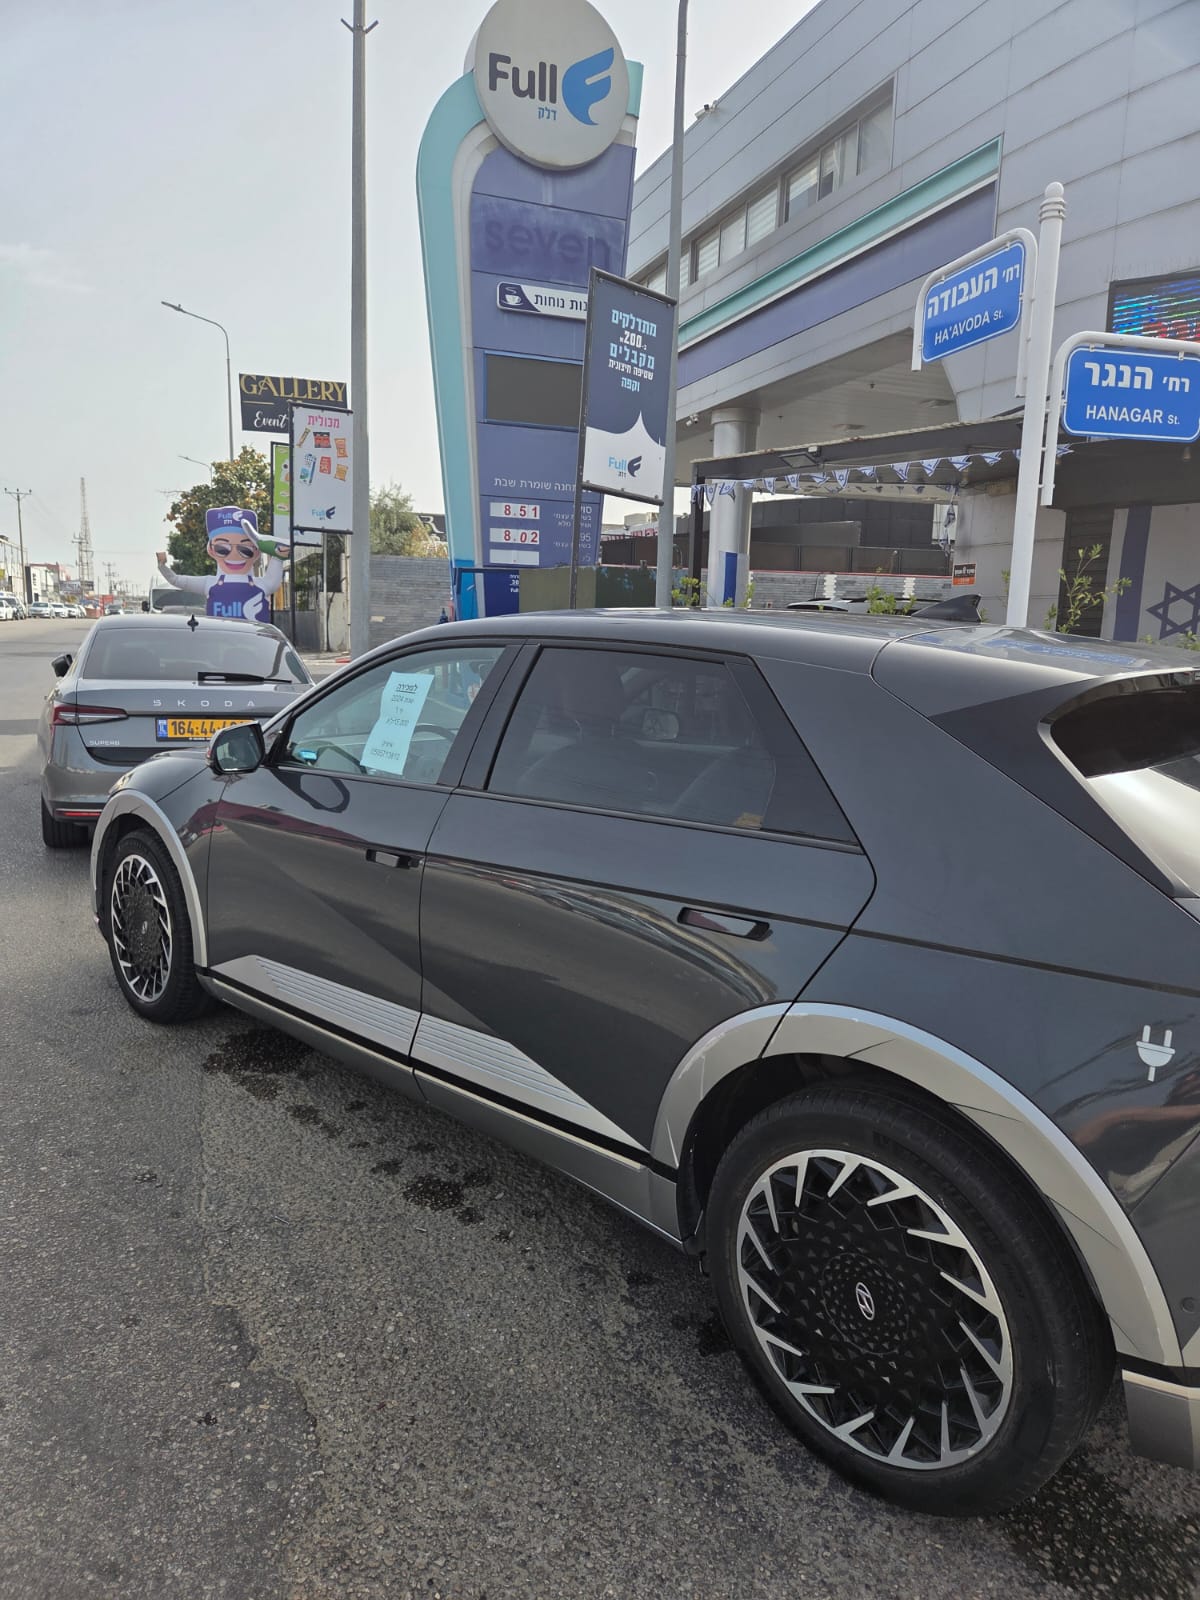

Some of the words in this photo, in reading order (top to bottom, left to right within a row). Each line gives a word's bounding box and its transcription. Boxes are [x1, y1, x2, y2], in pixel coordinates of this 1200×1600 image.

[489, 52, 557, 104] Full
[538, 106, 557, 121] דלק
[484, 217, 612, 272] seven
[927, 266, 997, 319] העבודה
[534, 294, 565, 309] נוחות
[570, 300, 588, 312] נות
[611, 309, 657, 338] מתדלקים
[934, 311, 991, 346] HA'AVODA
[993, 308, 1004, 321] St.
[609, 342, 655, 370] מקבלים
[608, 358, 632, 375] חיצונית
[633, 366, 654, 381] שטיפה
[1084, 361, 1153, 390] הנגר
[240, 373, 346, 401] GALLERY
[621, 376, 641, 393] וקפה
[254, 411, 288, 429] Event
[307, 415, 340, 428] מכולית
[1085, 404, 1163, 424] HANAGAR
[1167, 414, 1180, 425] St.
[608, 456, 627, 471] Full
[494, 477, 516, 487] שבת
[519, 479, 552, 490] שומרת
[217, 512, 233, 520] Full
[504, 504, 538, 518] 8.51
[504, 530, 538, 543] 8.02
[213, 601, 241, 617] Full
[152, 699, 256, 707] SKODA
